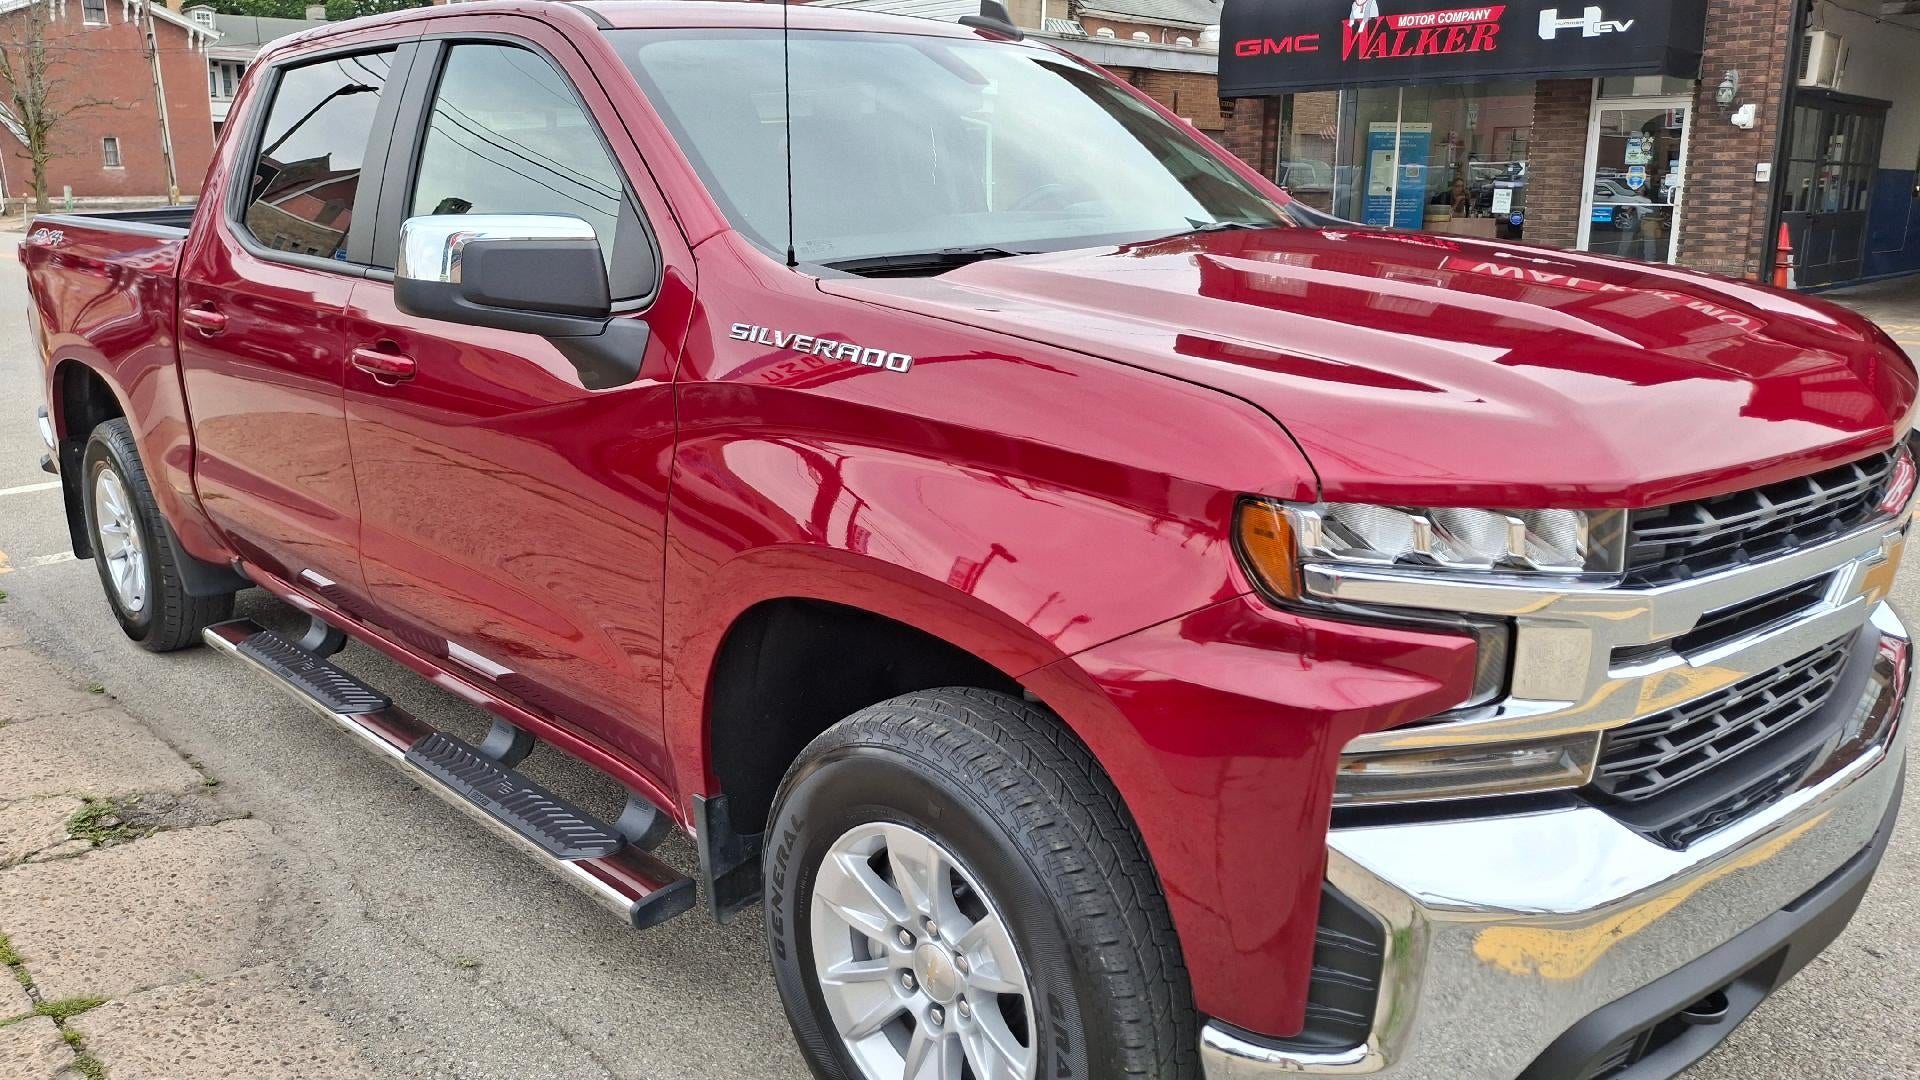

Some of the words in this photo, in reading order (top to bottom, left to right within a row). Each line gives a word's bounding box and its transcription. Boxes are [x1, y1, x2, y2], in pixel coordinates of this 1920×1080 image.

[1341, 15, 1500, 62] WALKER
[1398, 14, 1435, 27] MOTOR
[1438, 9, 1491, 24] COMPANY
[1235, 34, 1320, 57] GMC
[729, 323, 913, 373] SILVERADO
[771, 814, 805, 961] GENERAL
